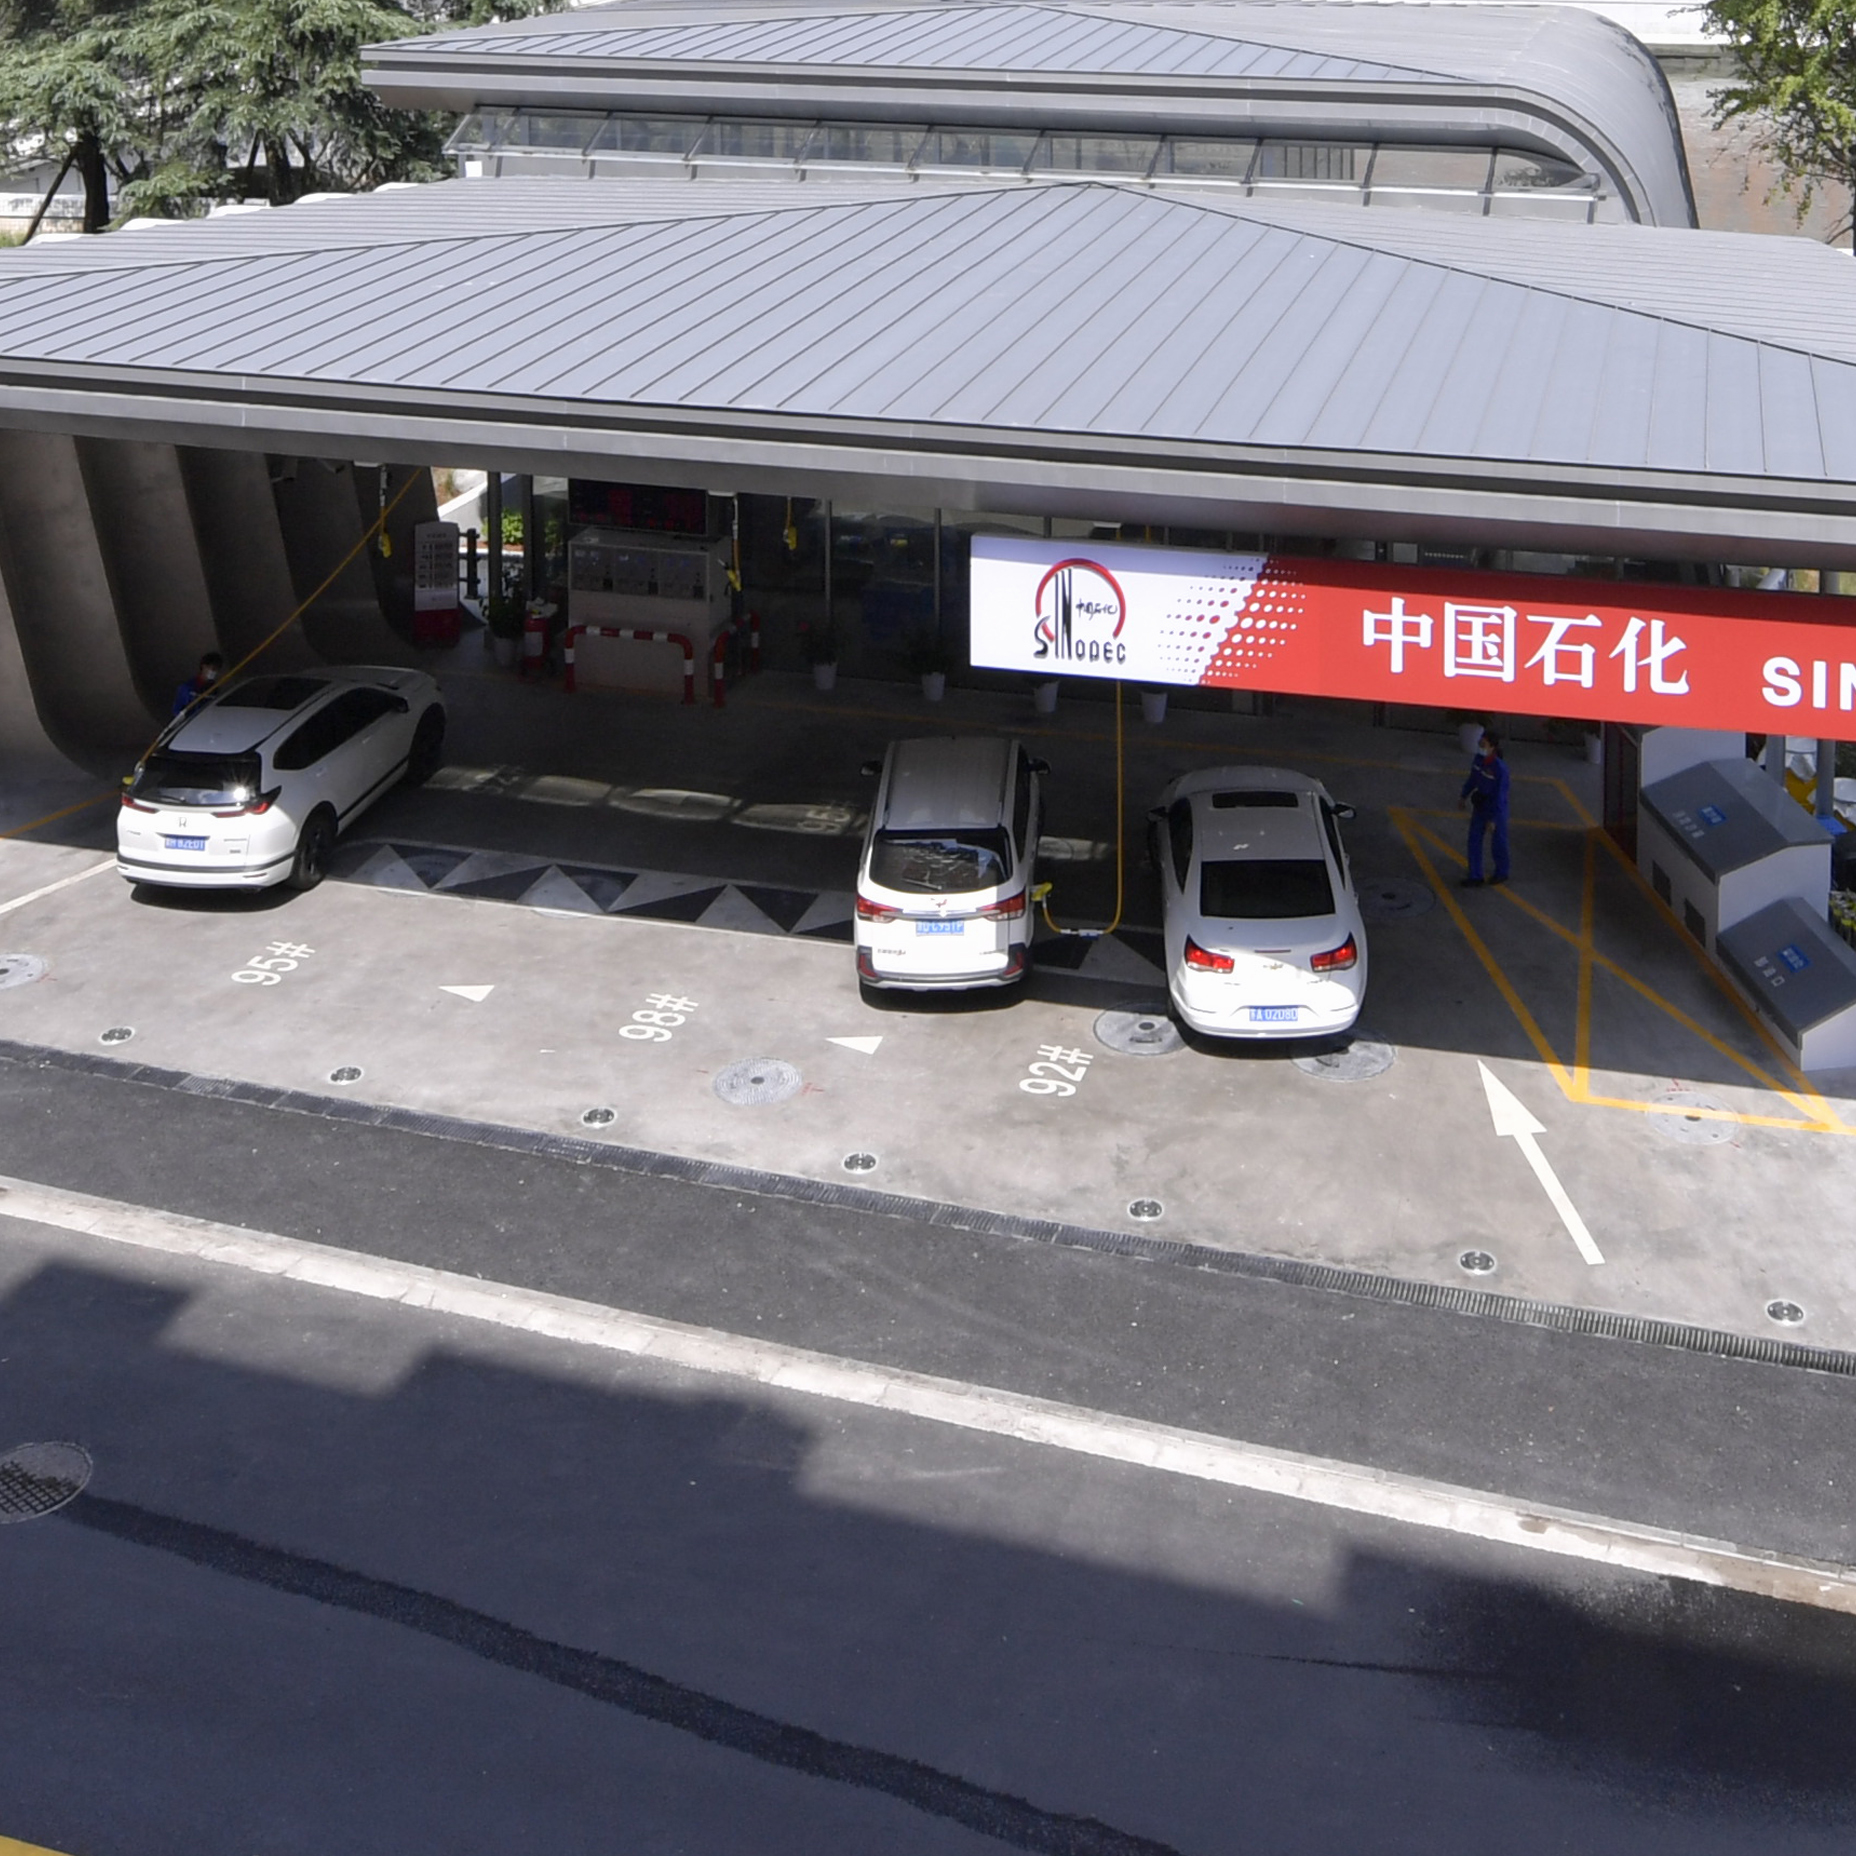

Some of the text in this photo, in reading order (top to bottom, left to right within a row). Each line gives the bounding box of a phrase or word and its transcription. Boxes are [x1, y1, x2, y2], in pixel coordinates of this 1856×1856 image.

[1361, 596, 1691, 697] 中国石化
[231, 941, 316, 987] 95#
[619, 992, 699, 1043] 98#
[1019, 1044, 1094, 1097] 92#
